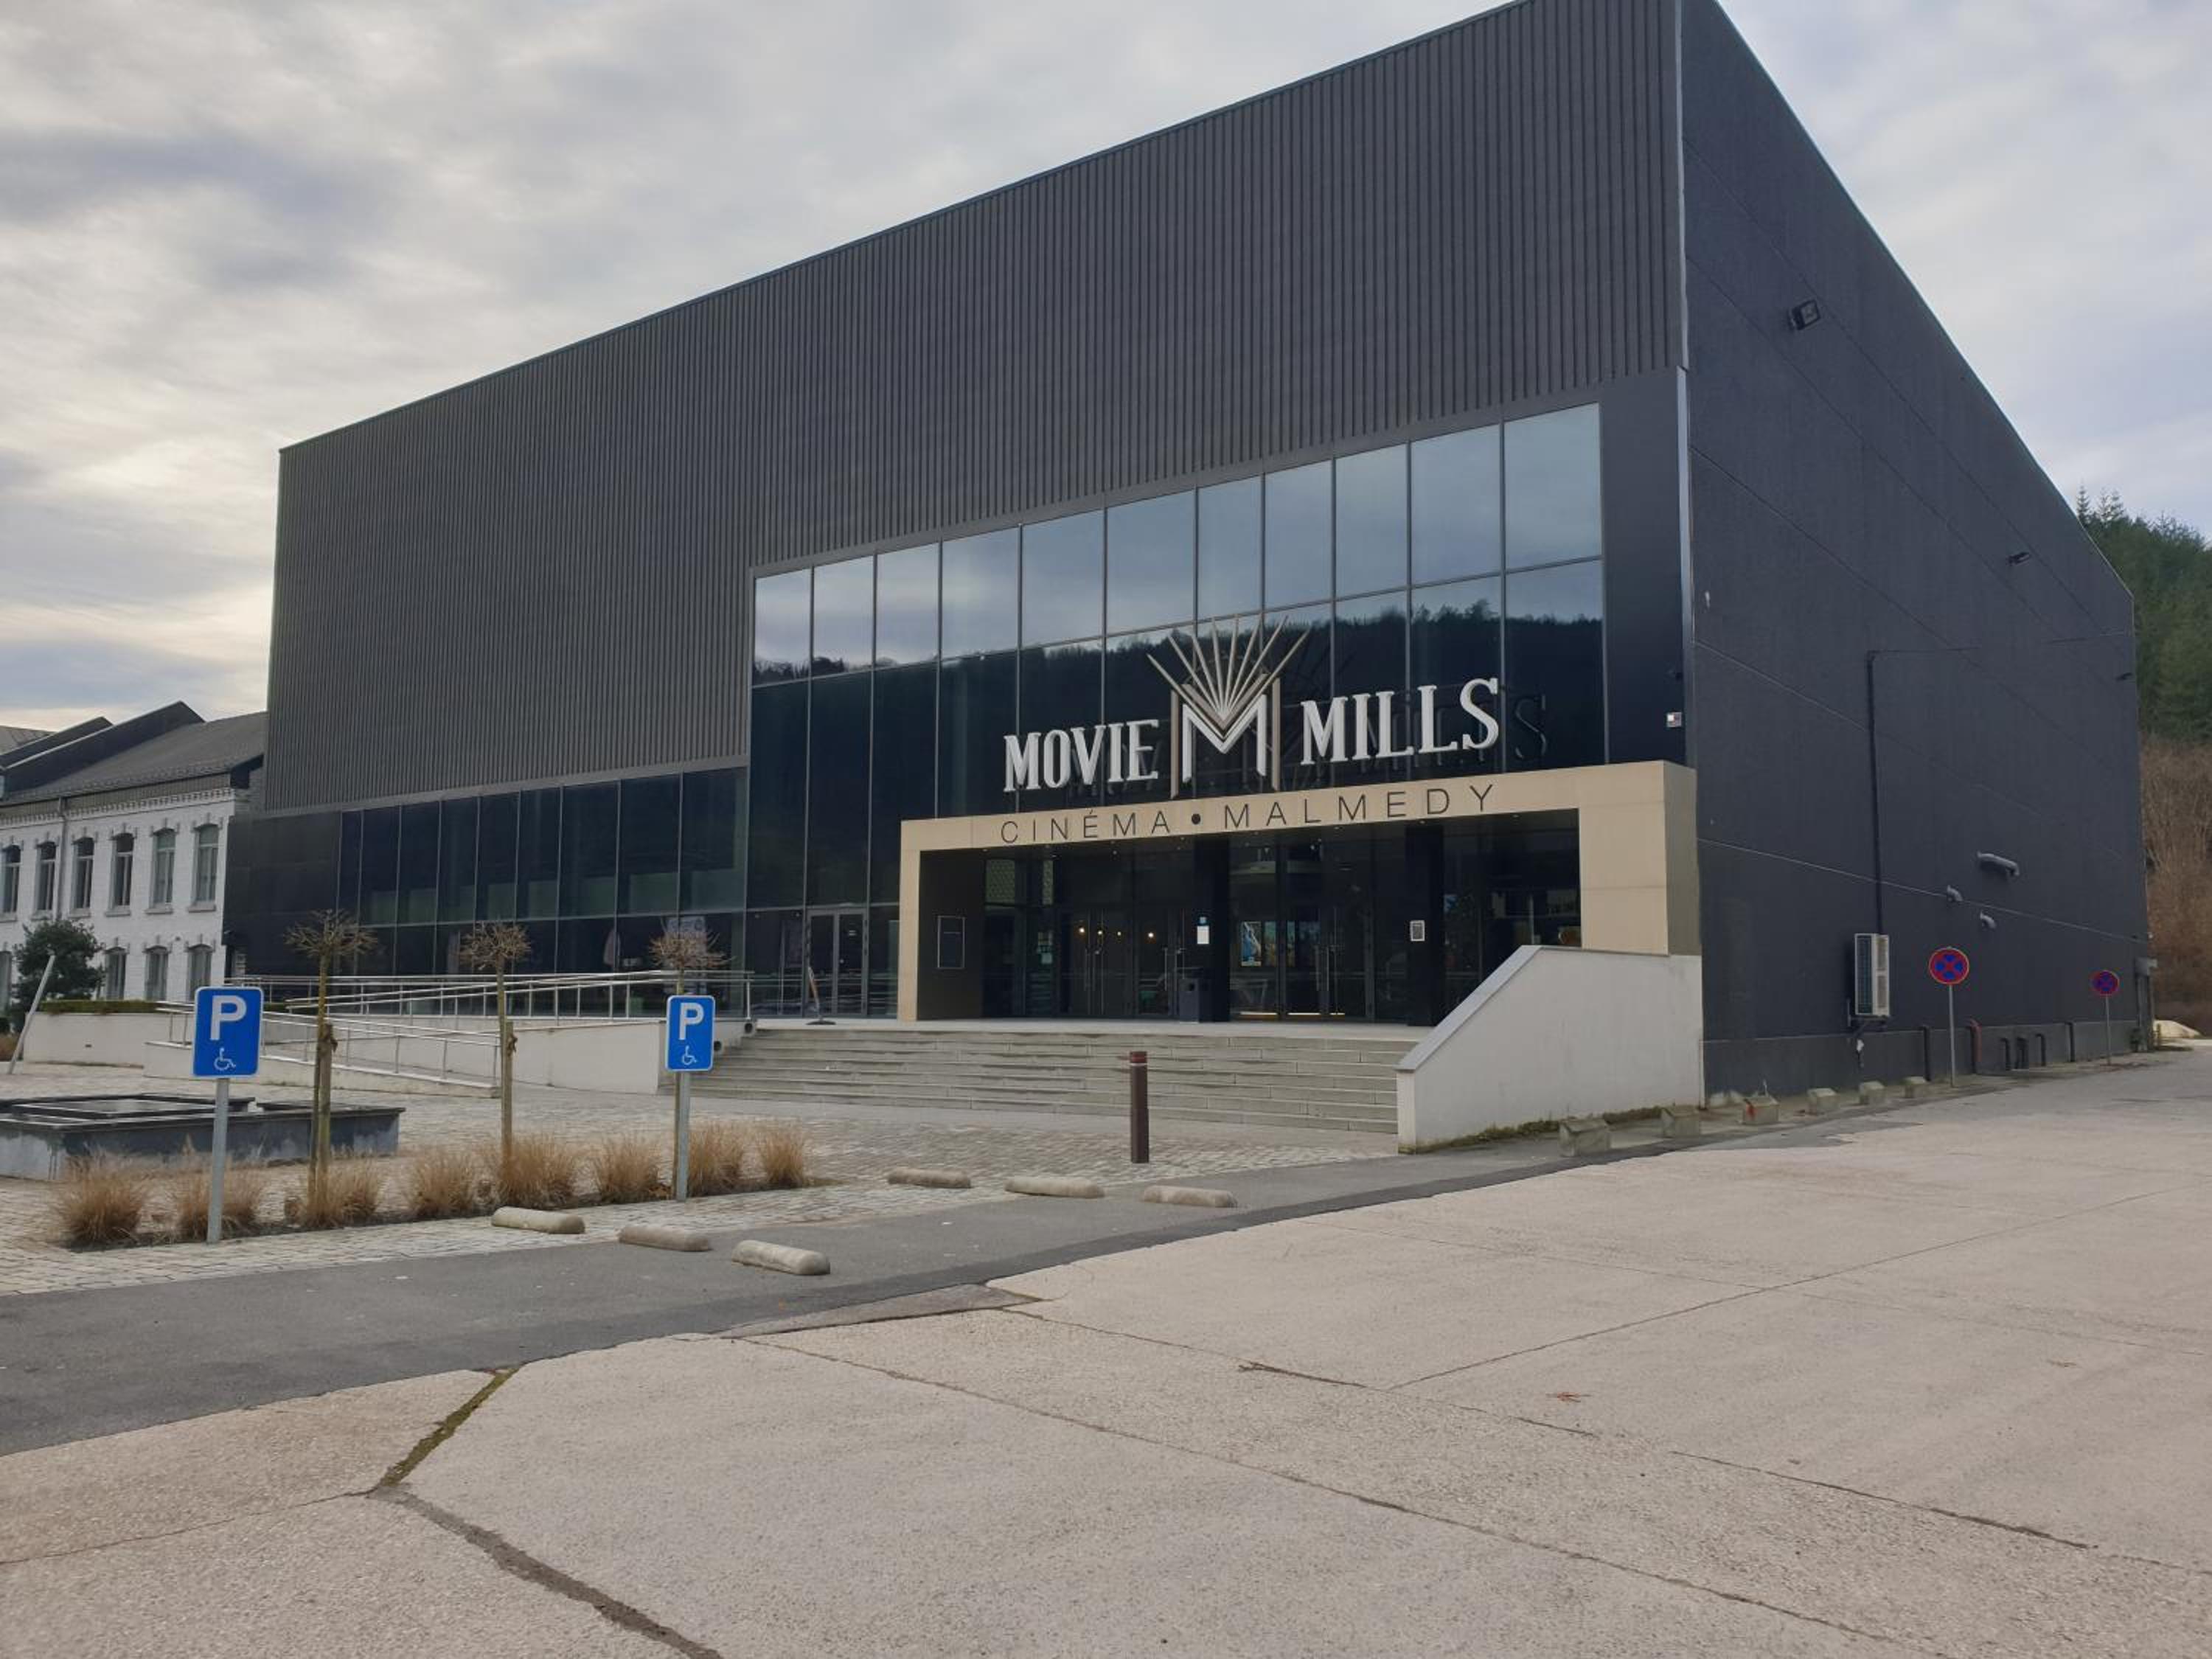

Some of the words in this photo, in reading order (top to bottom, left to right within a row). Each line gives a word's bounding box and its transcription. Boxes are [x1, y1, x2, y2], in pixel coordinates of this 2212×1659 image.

[1004, 720, 1160, 793] MOVIE
[1301, 678, 1499, 765] MILLS
[1001, 809, 1170, 844] CINÉMA
[1224, 785, 1493, 828] MALMEDY
[210, 995, 247, 1040] P
[679, 1003, 704, 1040] P
